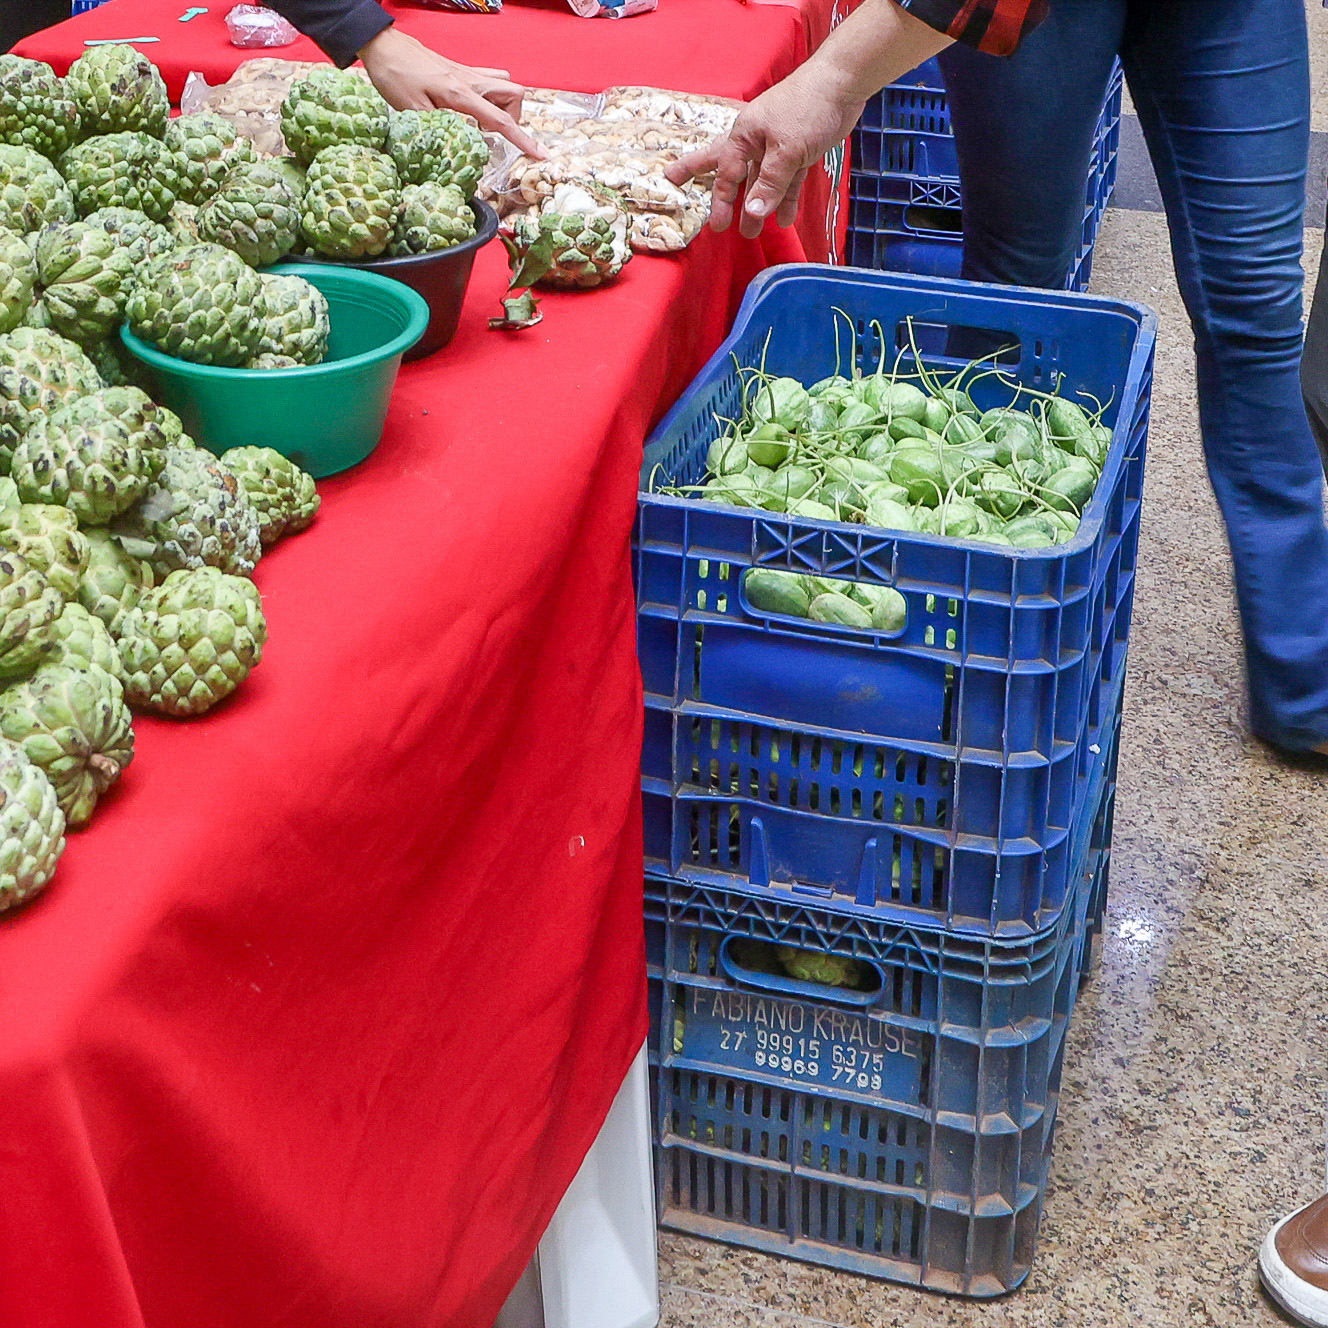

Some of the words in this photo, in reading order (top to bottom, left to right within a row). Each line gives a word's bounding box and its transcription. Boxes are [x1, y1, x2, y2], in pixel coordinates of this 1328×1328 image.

[693, 987, 805, 1034] FABIANO
[813, 1007, 919, 1059] KRAUSE
[720, 1029, 748, 1052] 27
[755, 1028, 821, 1060] 99915
[831, 1043, 885, 1073] 6375
[754, 1050, 819, 1077] 99969
